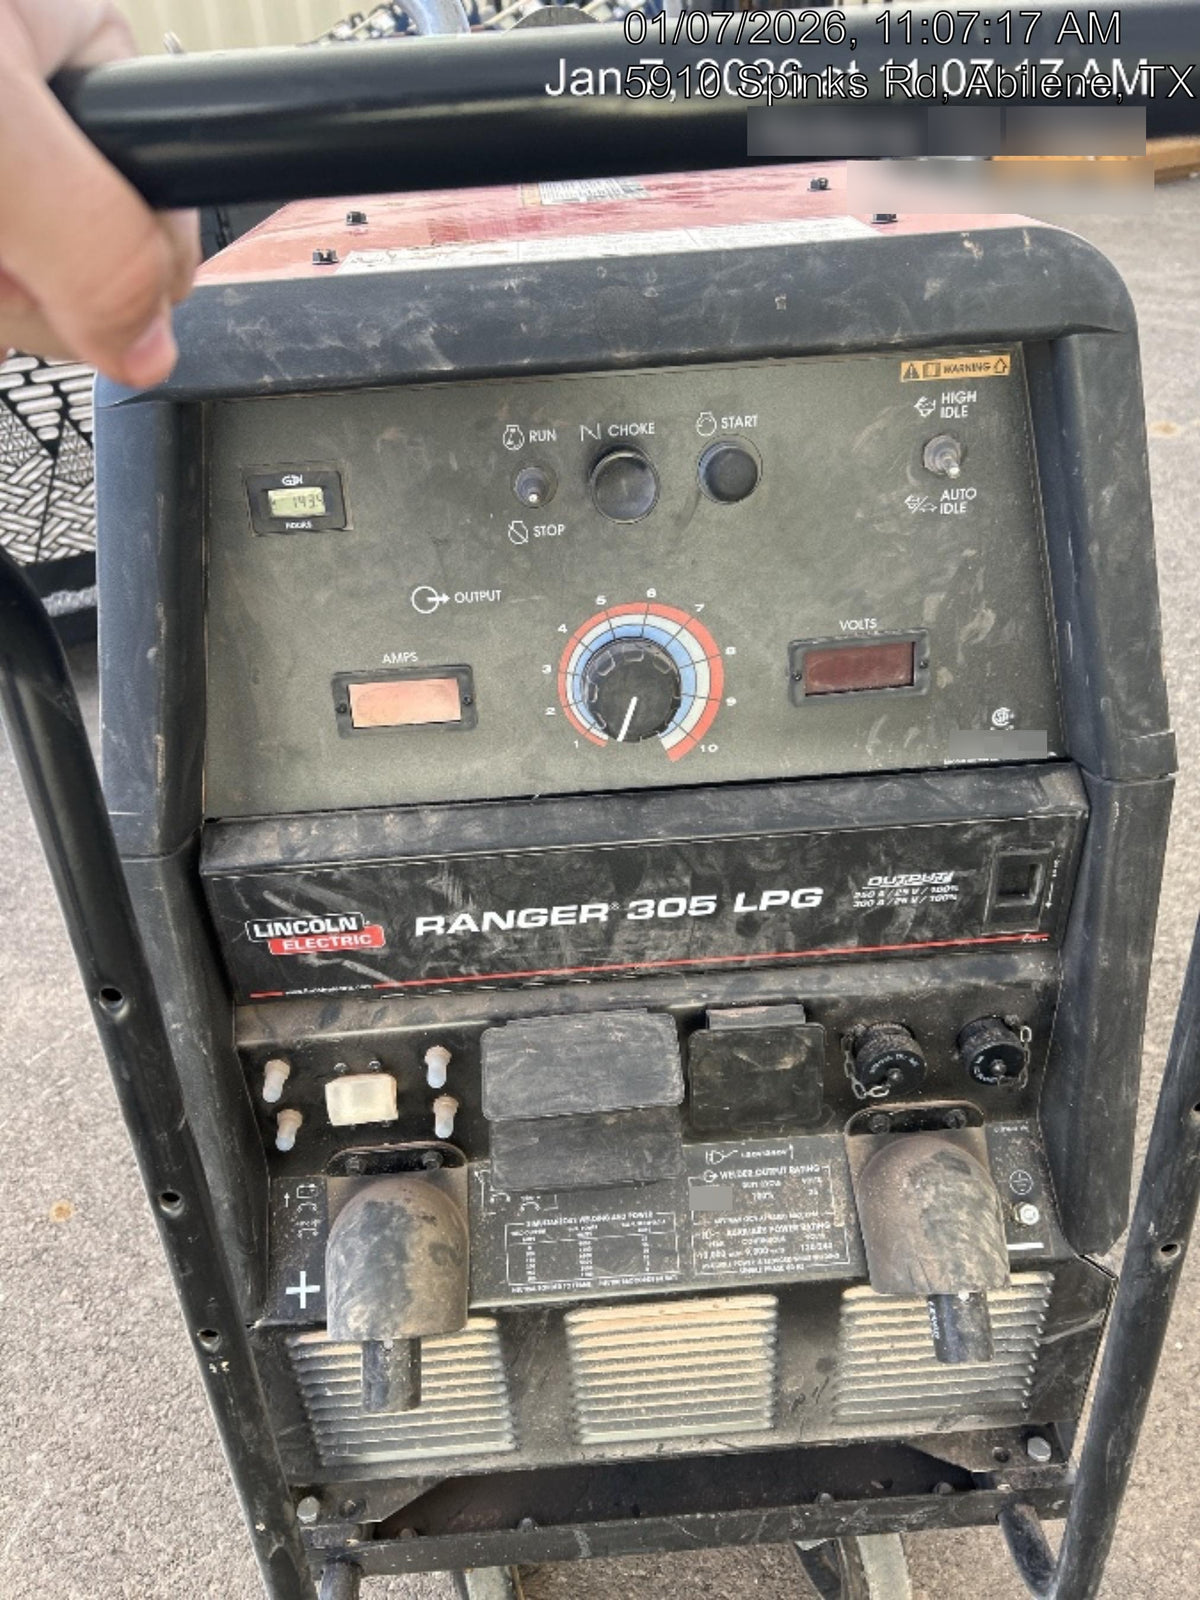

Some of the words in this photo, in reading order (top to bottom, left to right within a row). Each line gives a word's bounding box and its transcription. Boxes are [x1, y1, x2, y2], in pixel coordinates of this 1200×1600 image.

[943, 362, 991, 375] WARNING
[941, 390, 977, 405] HIGH
[940, 405, 968, 419] IDLE
[720, 414, 759, 430] START
[608, 422, 655, 437] CHOKE
[528, 430, 557, 443] RUN
[940, 487, 977, 502] AUTO
[940, 501, 967, 515] IDLE
[532, 524, 565, 538] STOP
[454, 589, 502, 604] OUTPUT
[646, 587, 657, 598] 6
[596, 595, 607, 606] 5
[694, 603, 705, 613] 7
[557, 623, 568, 633] 4
[838, 618, 877, 631] VOLTS
[382, 651, 418, 664] AMPS
[544, 706, 556, 716] 2
[573, 738, 579, 749] 1
[700, 743, 719, 753] 10
[627, 895, 717, 921] 305
[734, 888, 824, 914] LPG
[253, 917, 358, 938] LINCOLN
[282, 934, 372, 950] ELECTRIC
